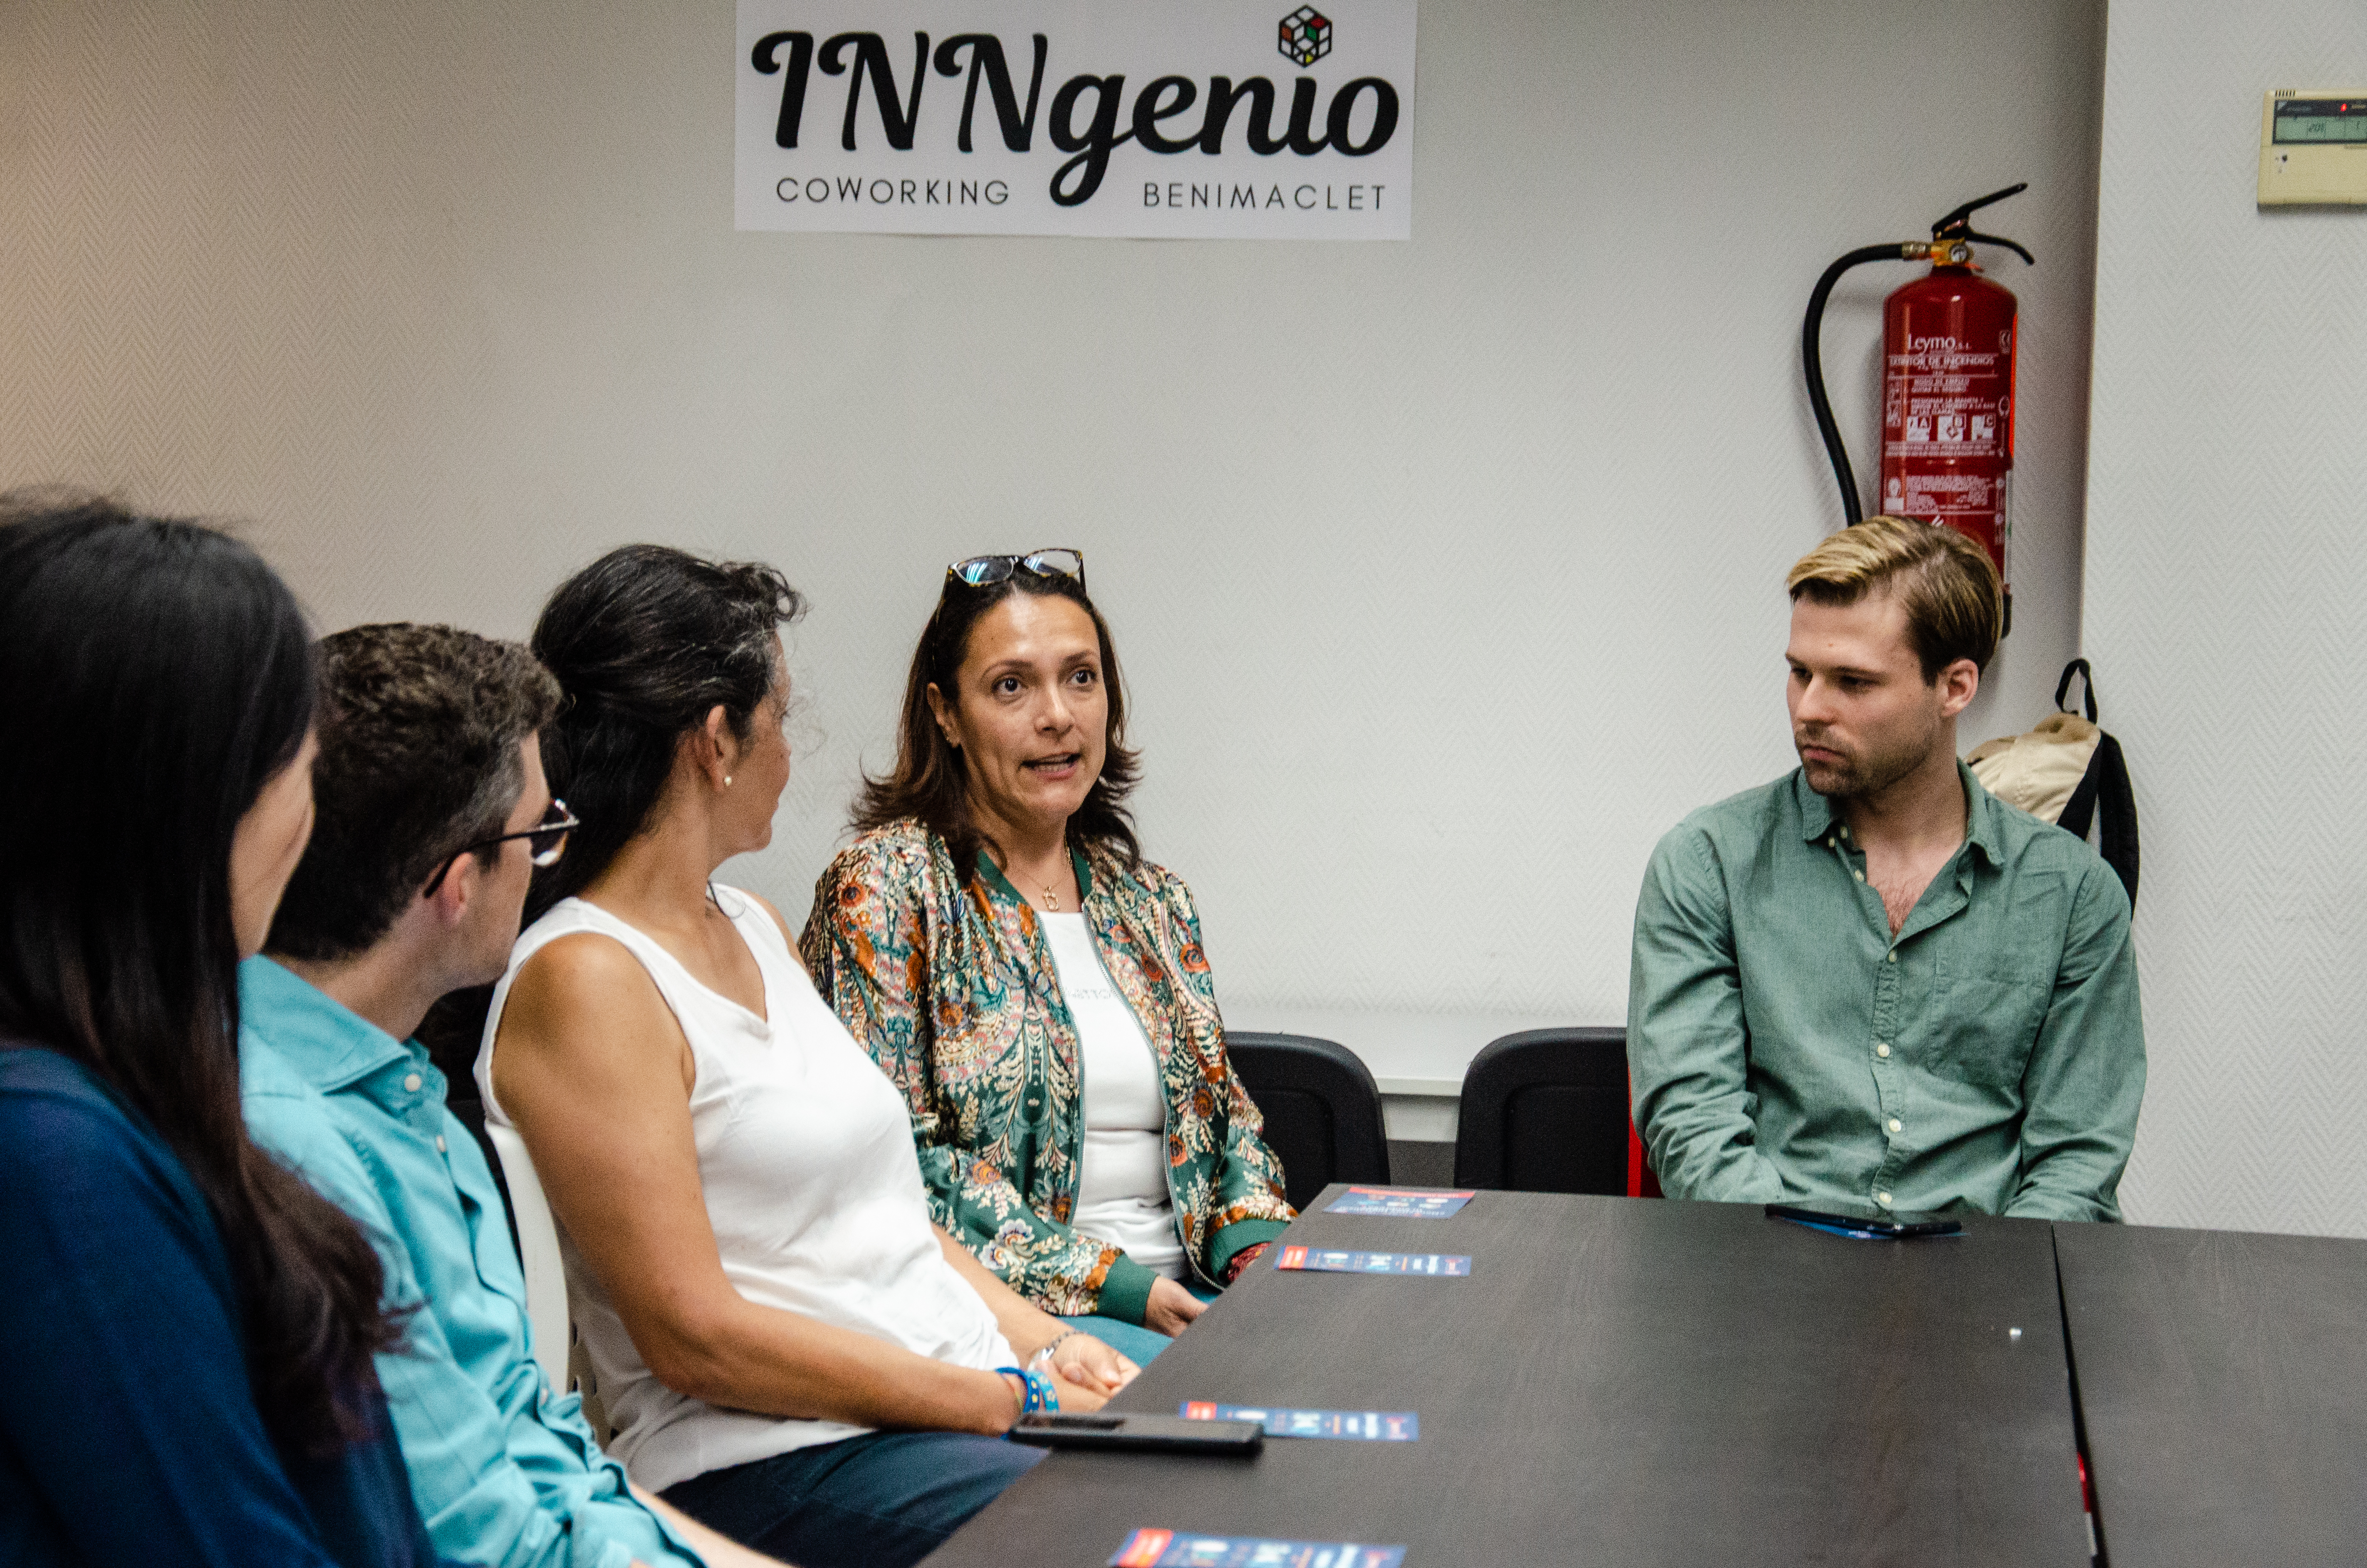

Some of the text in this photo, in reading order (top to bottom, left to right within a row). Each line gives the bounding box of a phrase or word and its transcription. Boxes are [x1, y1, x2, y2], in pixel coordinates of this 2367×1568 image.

[751, 30, 1399, 208] INNgenio
[775, 177, 1386, 210] COWORKING BENIMACLET
[1907, 333, 1956, 356] Leymo
[1919, 417, 1928, 428] A
